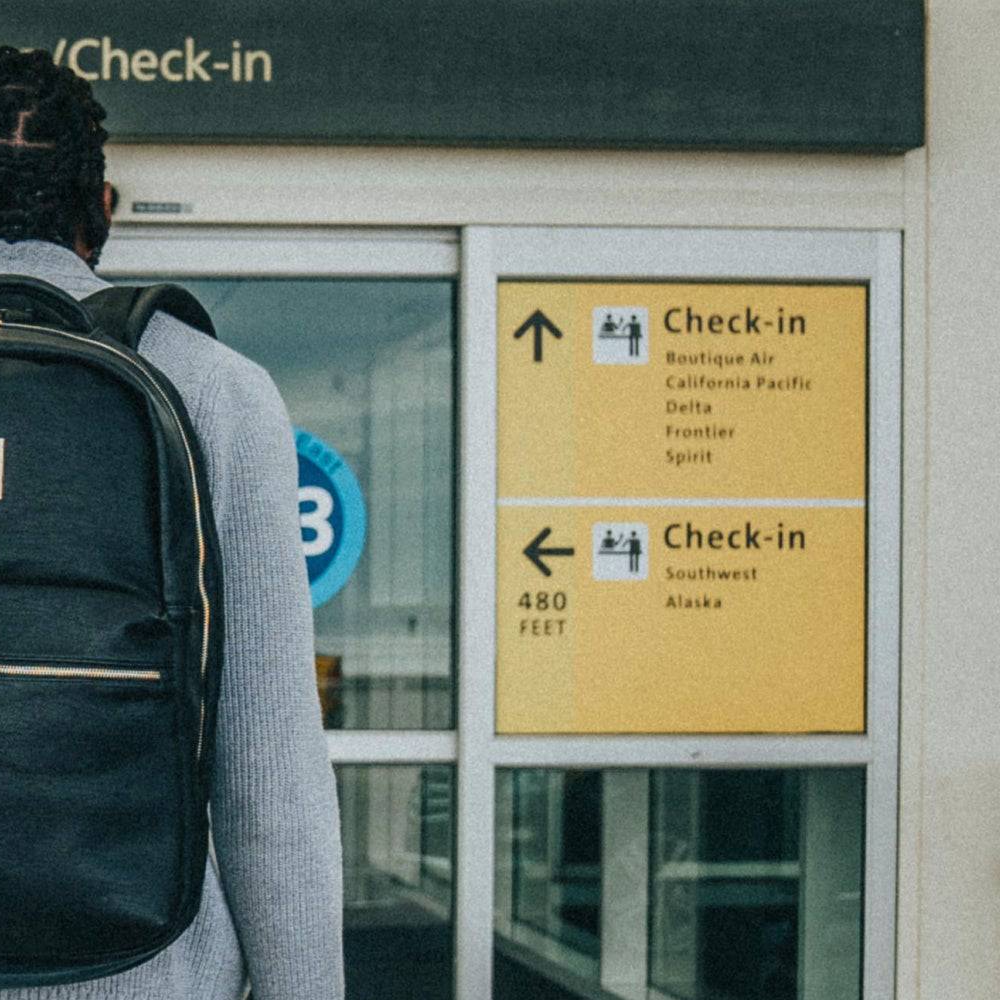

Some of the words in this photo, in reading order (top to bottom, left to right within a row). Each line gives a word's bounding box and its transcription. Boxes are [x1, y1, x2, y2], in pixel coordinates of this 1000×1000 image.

[664, 306, 806, 335] Check-in
[665, 351, 745, 369] Boutique
[750, 351, 775, 365] Air
[665, 375, 751, 390] California
[756, 376, 813, 390] Pacific
[665, 400, 712, 415] Delta
[665, 425, 735, 439] Frontier
[665, 450, 713, 467] Spirit
[664, 522, 806, 550] Check-in
[665, 566, 758, 581] Southwest
[518, 591, 567, 611] 480
[665, 594, 722, 609] Alaska
[519, 619, 566, 636] FEET
